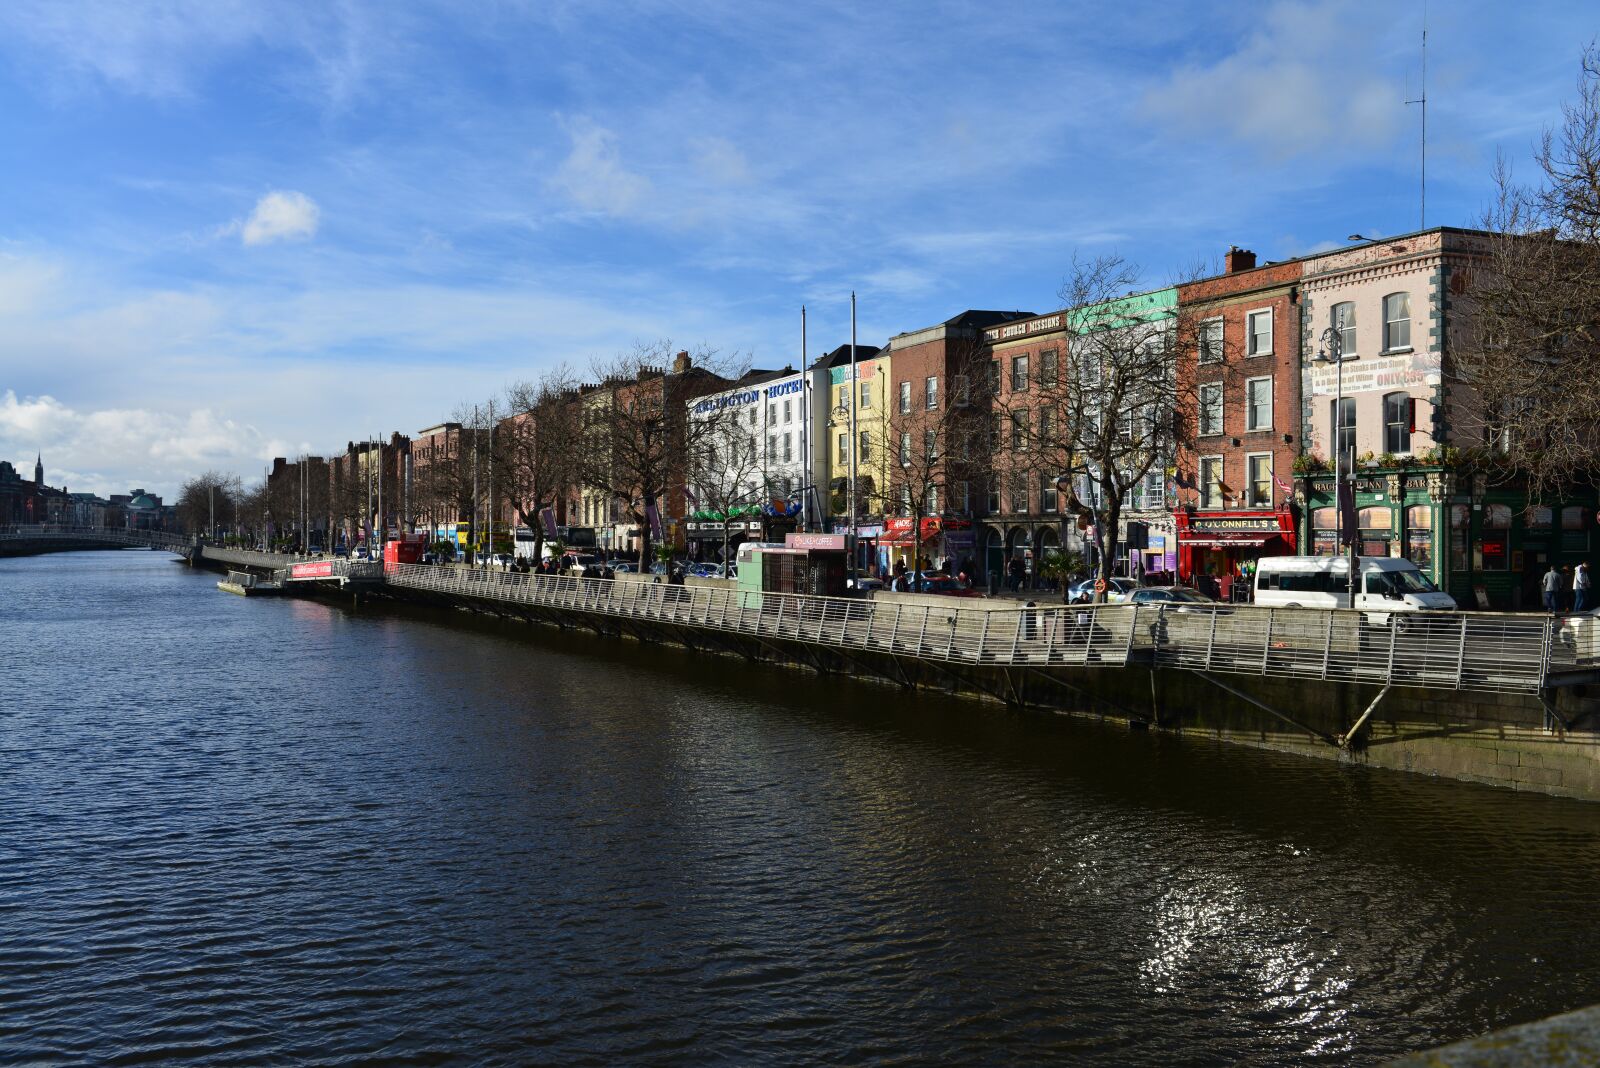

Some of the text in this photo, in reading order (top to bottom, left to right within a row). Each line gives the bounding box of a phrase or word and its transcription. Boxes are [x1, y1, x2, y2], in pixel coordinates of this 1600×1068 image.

[1029, 316, 1060, 332] MISSIONS
[1350, 363, 1369, 373] Steaks
[1378, 360, 1388, 370] the
[1326, 375, 1346, 386] Boe
[1356, 373, 1373, 383] Wine
[1376, 372, 1401, 387] ONLY
[695, 390, 760, 414] ARLINGTON
[1406, 479, 1427, 488] BAR
[1205, 520, 1268, 528] O'CONNELL'S
